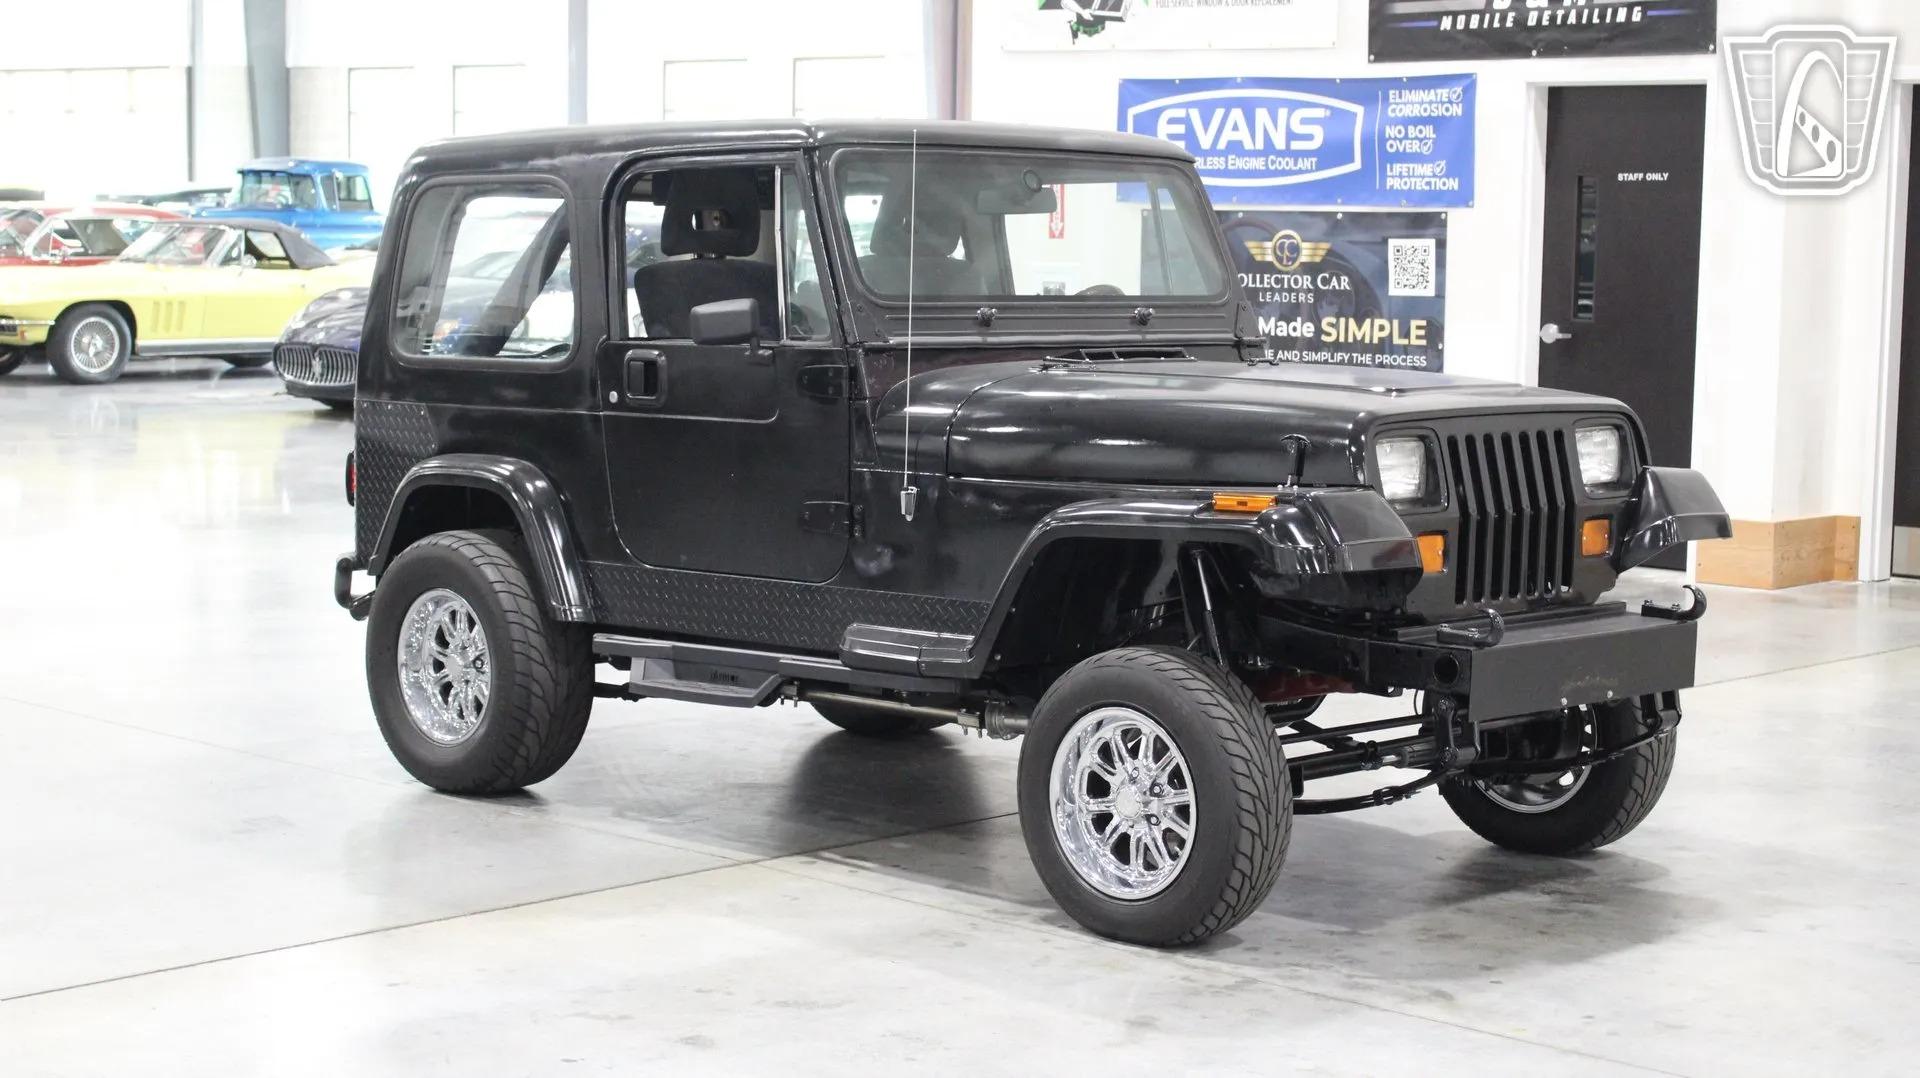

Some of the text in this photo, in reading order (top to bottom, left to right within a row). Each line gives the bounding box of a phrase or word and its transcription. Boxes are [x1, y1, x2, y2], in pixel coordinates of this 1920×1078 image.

[1440, 6, 1642, 31] MOBILE DETAILING
[1388, 89, 1449, 103] ELIMINATE
[1387, 103, 1463, 118] CORROSION
[1156, 107, 1326, 151] EVANS
[1385, 125, 1436, 140] NO BOIL
[1386, 140, 1420, 153] OVER
[1193, 156, 1226, 171] RLESS
[1386, 163, 1433, 177] LIFETIME
[1386, 177, 1459, 191] PROTECTION
[1617, 172, 1669, 182] STAFF ONLY
[1237, 273, 1314, 290] OLLECTOR
[1259, 291, 1315, 303] LEADERS
[1257, 315, 1428, 346] Made SIMPLE
[1276, 350, 1300, 363] AND
[1302, 350, 1350, 364] SIMPLIFY
[1351, 352, 1373, 365] THE
[1375, 353, 1428, 367] PROCESS
